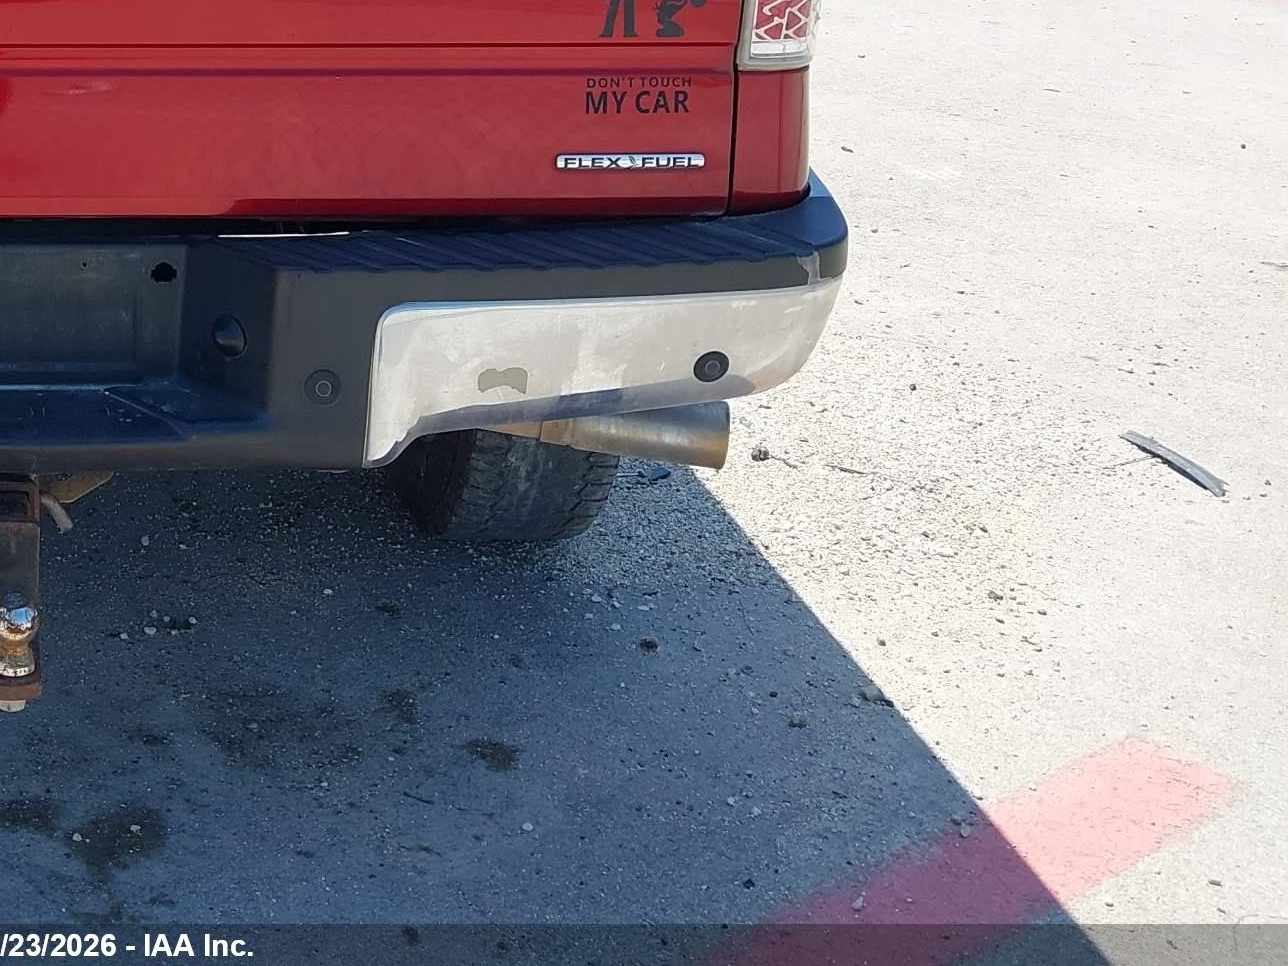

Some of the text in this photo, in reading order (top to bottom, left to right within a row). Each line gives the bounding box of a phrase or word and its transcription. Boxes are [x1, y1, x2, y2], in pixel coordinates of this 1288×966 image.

[586, 76, 692, 88] DON'T TOUCH
[585, 90, 690, 114] MY CAR
[563, 156, 699, 168] FLEX FUEL
